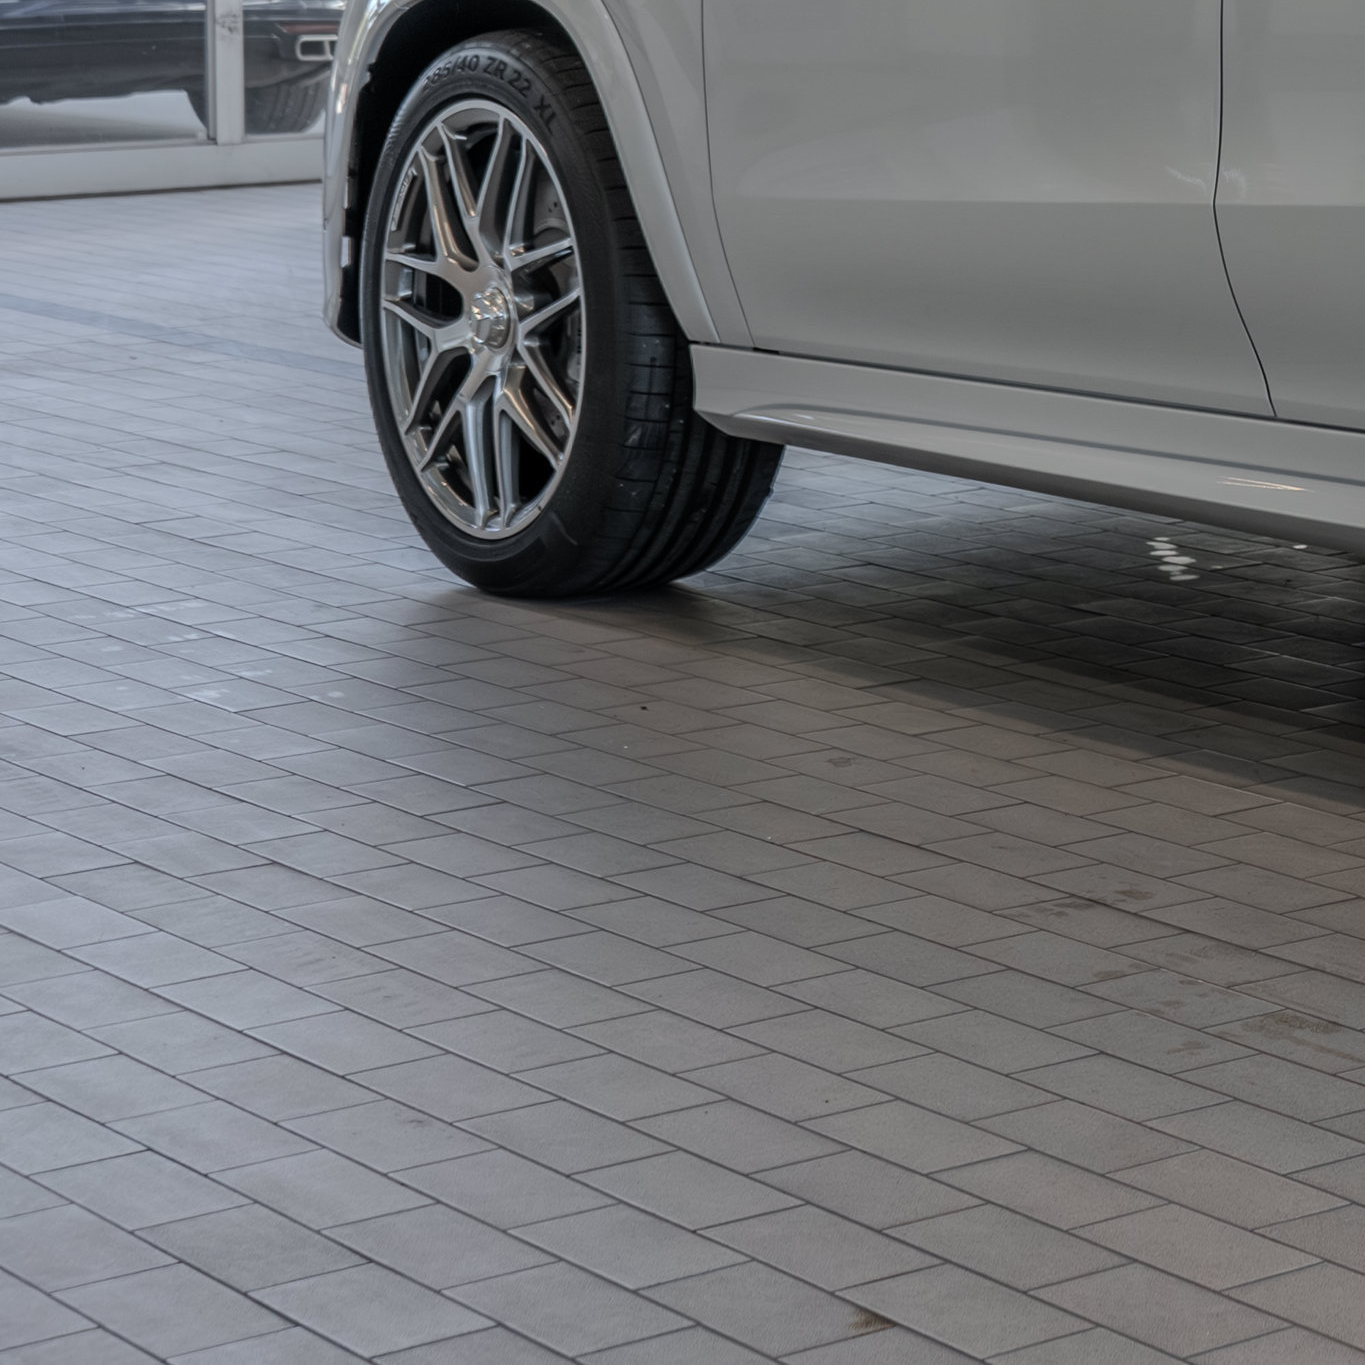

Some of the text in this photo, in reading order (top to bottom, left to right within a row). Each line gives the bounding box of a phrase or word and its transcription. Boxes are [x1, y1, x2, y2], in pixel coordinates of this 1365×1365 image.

[483, 56, 508, 80] ZR
[507, 70, 532, 98] 22
[534, 95, 557, 134] XL
